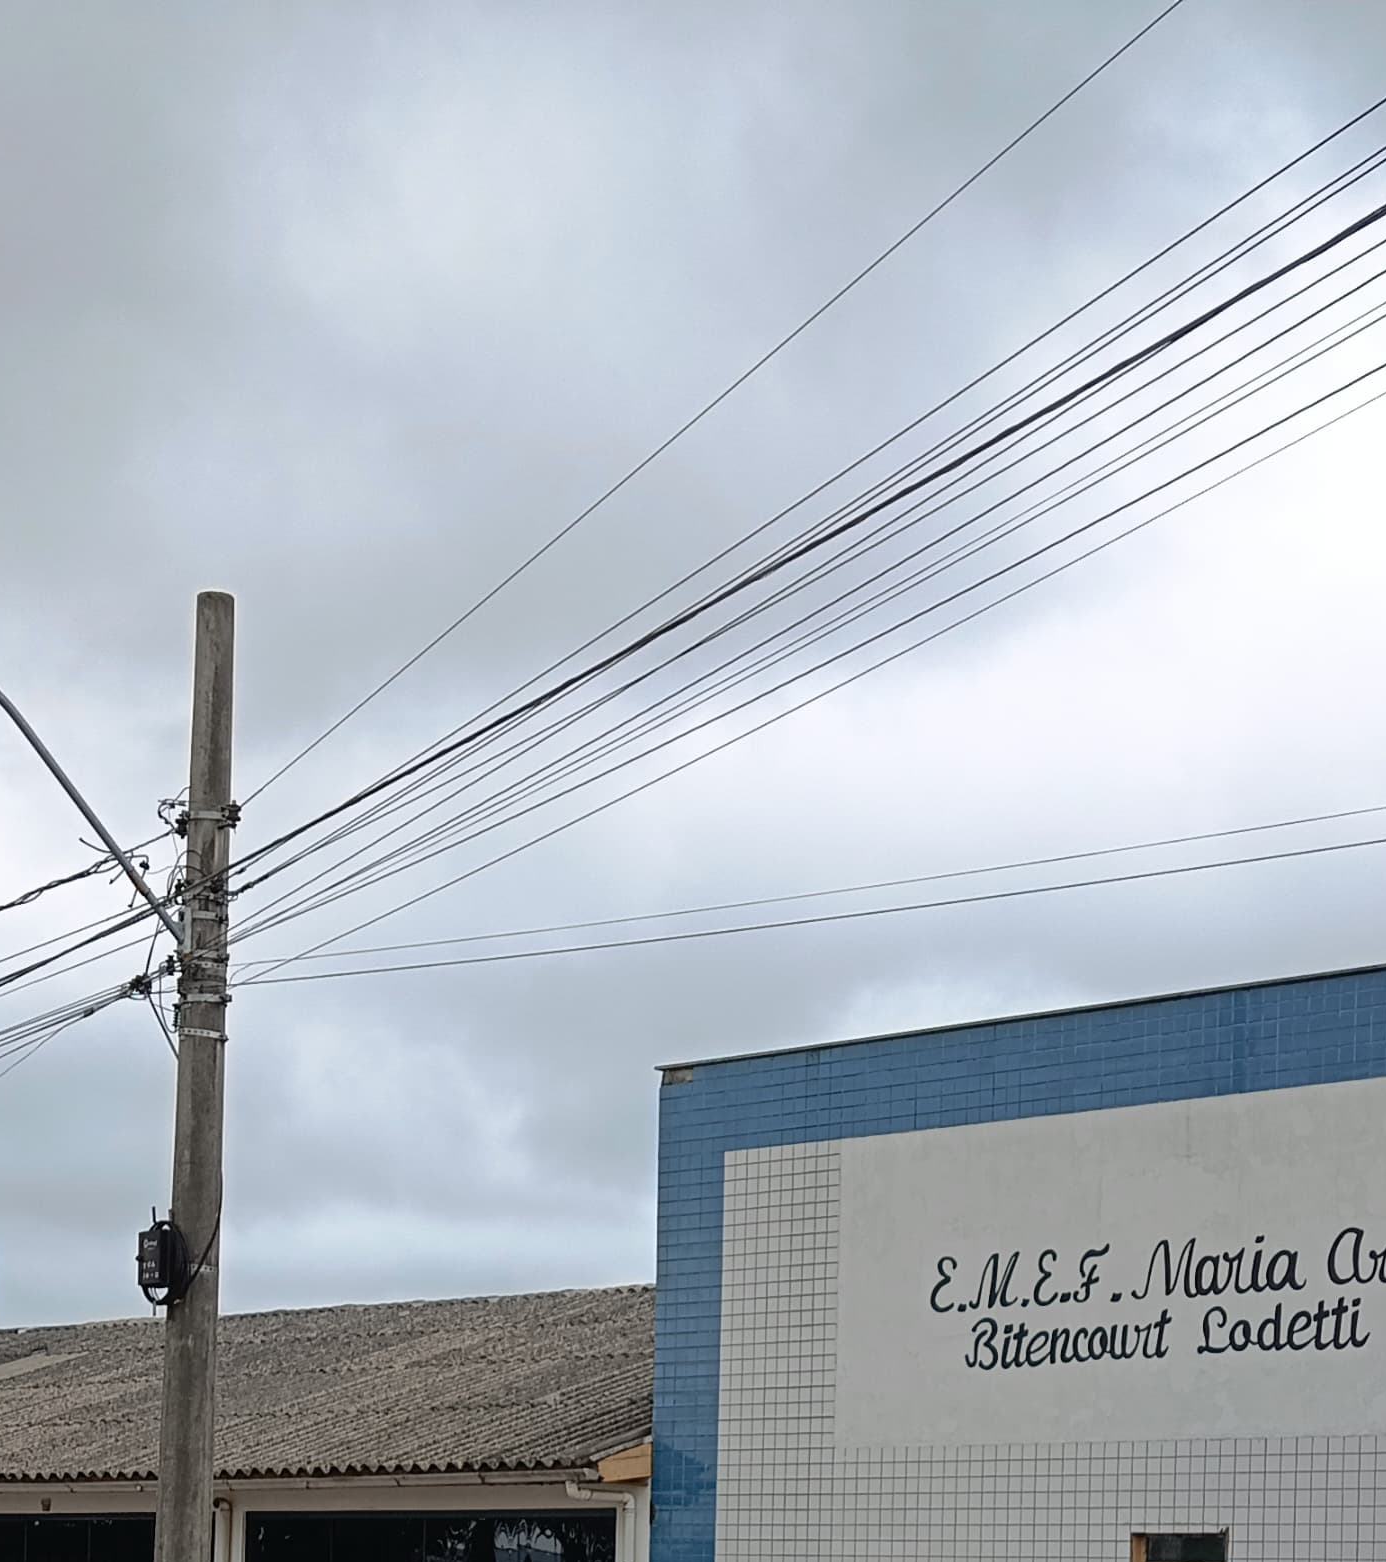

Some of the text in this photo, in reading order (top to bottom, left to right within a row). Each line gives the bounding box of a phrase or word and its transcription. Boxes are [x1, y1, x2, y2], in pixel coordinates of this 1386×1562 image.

[1131, 1235, 1307, 1300] Maria
[965, 1297, 1371, 1371] Bitencourt Lodetti
